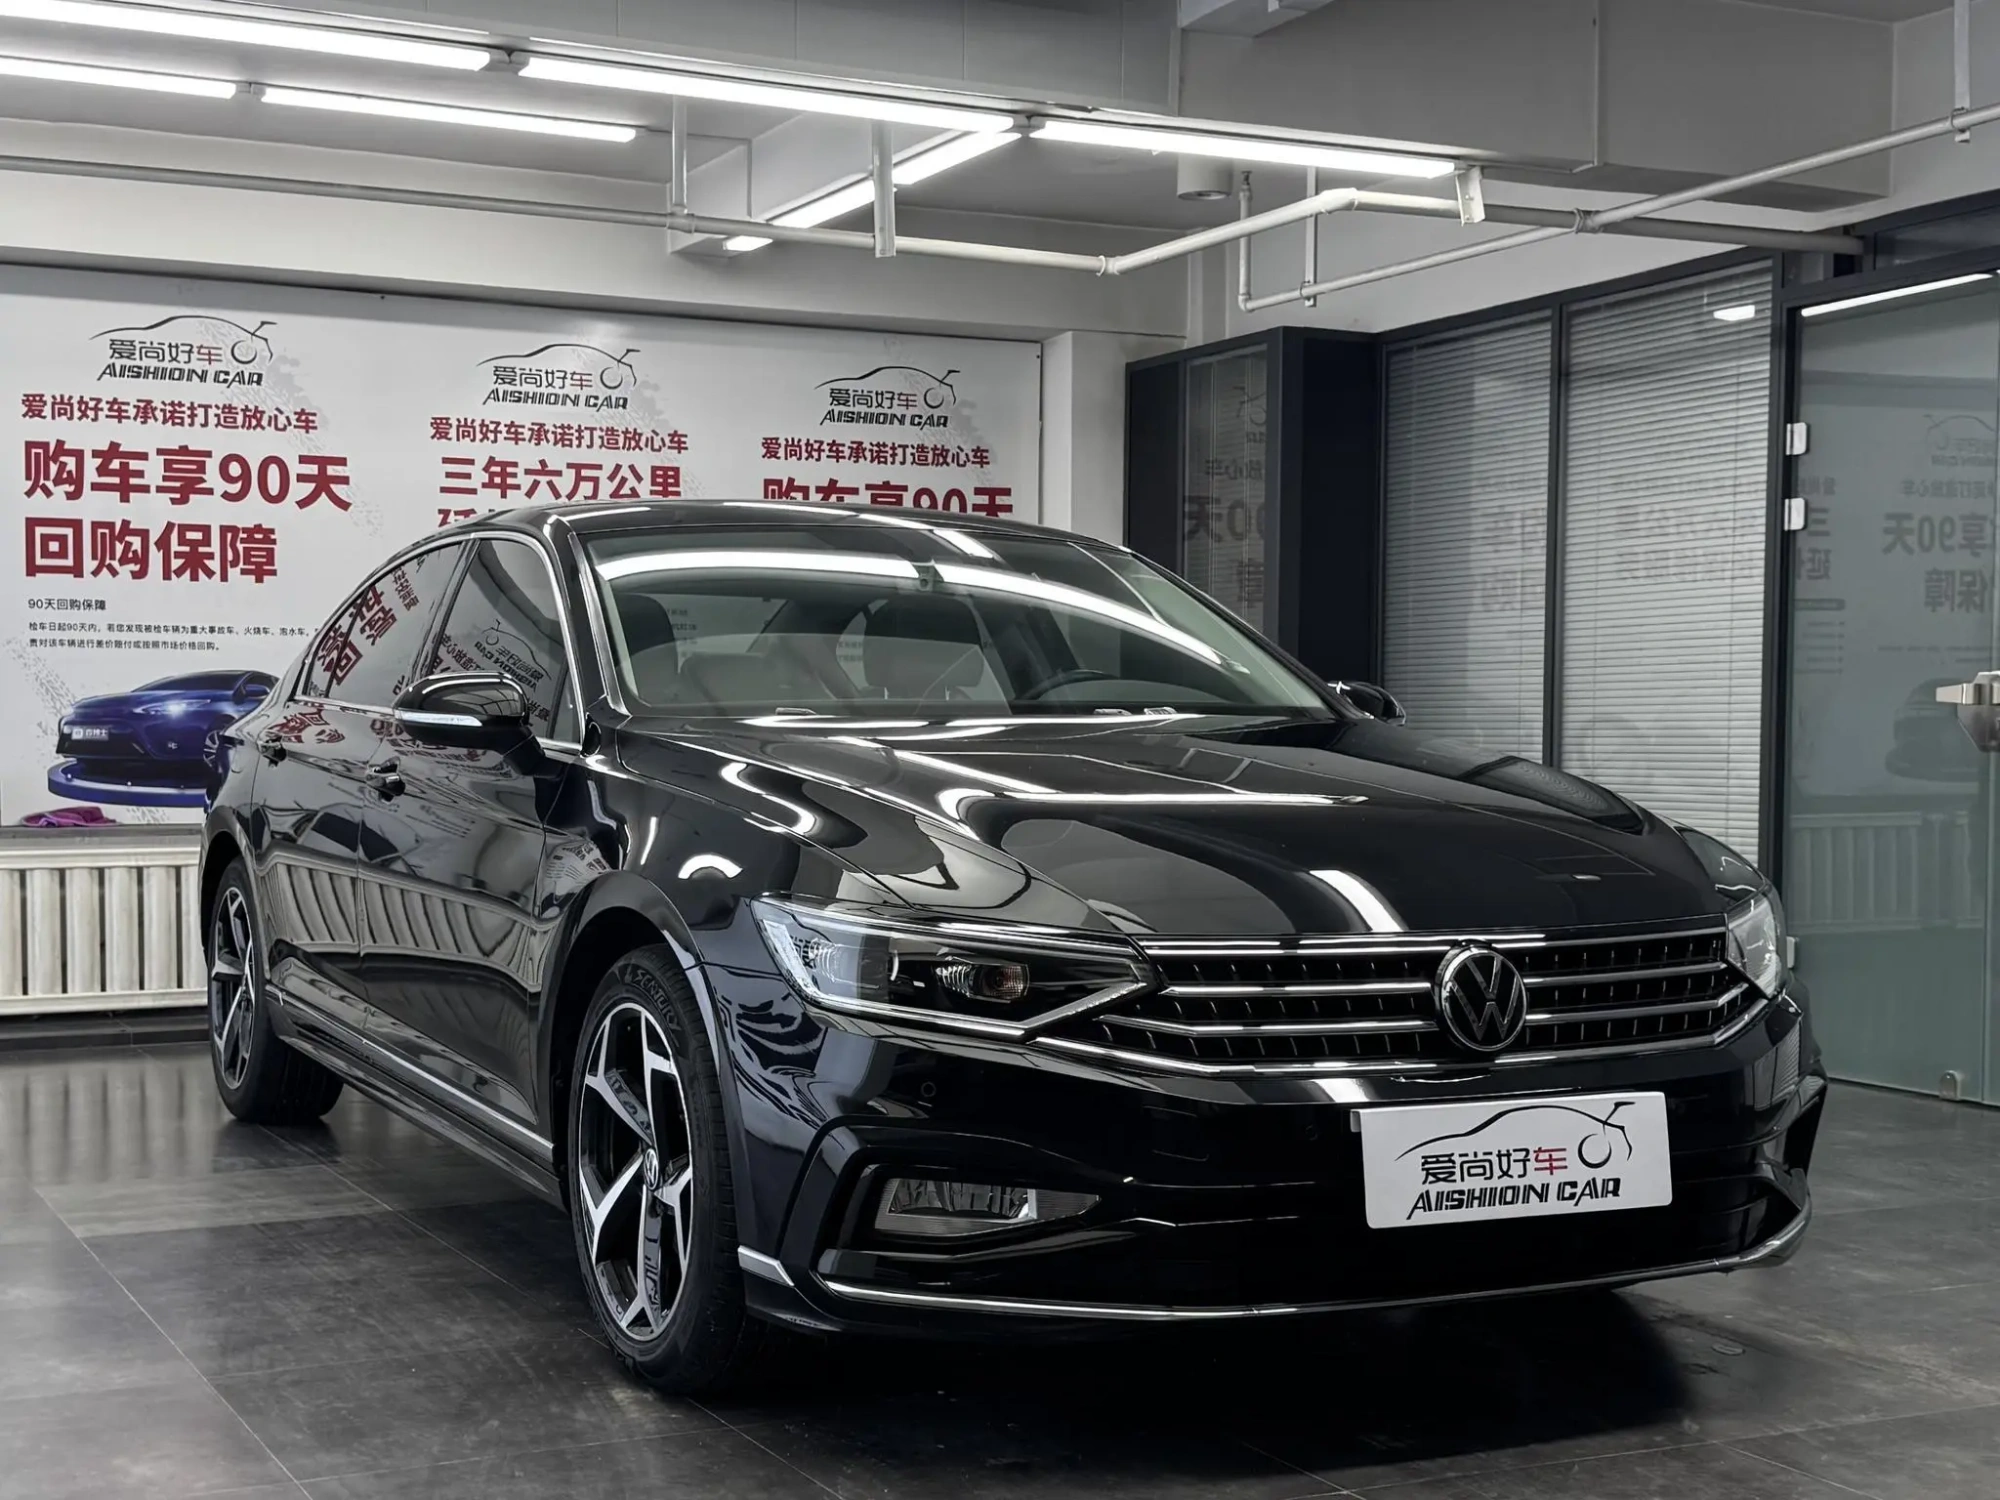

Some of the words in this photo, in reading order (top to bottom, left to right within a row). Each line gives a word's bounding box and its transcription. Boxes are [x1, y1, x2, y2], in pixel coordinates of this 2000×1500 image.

[109, 338, 224, 365] 爱尚好车
[213, 370, 263, 388] CAR
[492, 365, 593, 390] 爱尚好车
[21, 394, 318, 433] 爱尚好车承诺打造放心车
[584, 395, 628, 412] CAR
[829, 388, 918, 410] 爱尚好车
[430, 416, 689, 454] 爱尚好车承诺打造放心车
[909, 414, 949, 431] CAR
[761, 437, 990, 469] 爱尚好车承诺打造放心车
[23, 438, 353, 512] 购车享90天
[439, 456, 682, 501] 三年六万公里
[25, 516, 278, 584] 回购保障
[28, 598, 106, 611] 90天回购保障
[1421, 1146, 1568, 1185] 爱尚好车
[1406, 1181, 1549, 1220] AISHION
[1557, 1176, 1621, 1206] CAR
